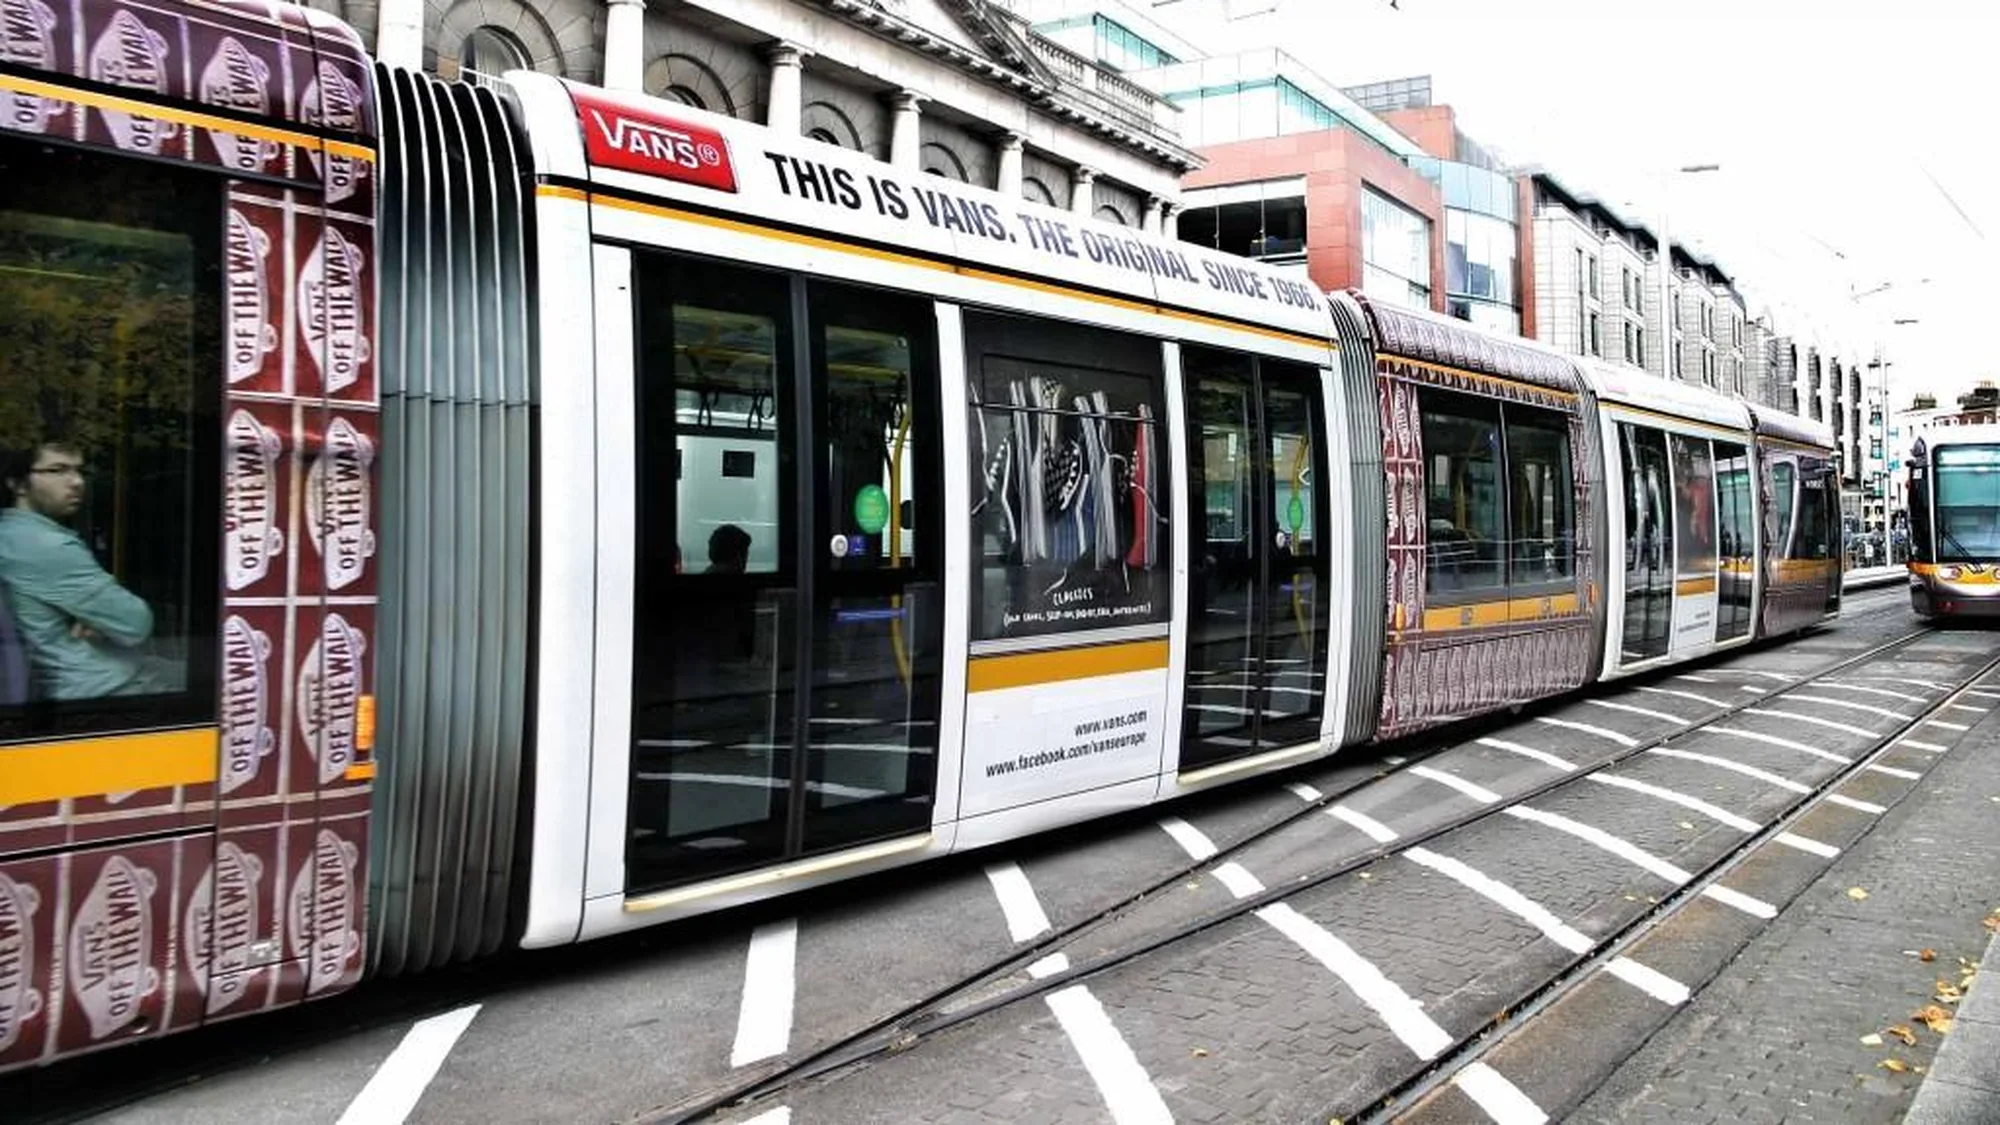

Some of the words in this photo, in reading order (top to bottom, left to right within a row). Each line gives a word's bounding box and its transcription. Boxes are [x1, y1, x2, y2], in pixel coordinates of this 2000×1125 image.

[763, 150, 862, 210] THIS
[867, 174, 909, 220] IS
[911, 186, 1017, 244] VANS.
[1016, 212, 1079, 258] THE
[1080, 229, 1200, 284] ORIGINAL
[1201, 259, 1269, 301] SINCE
[1268, 276, 1322, 312] 1966.
[325, 241, 352, 288] WALL
[232, 280, 258, 323] THE
[329, 292, 354, 334] THE
[234, 329, 257, 364] OFF
[332, 340, 352, 374] OFF
[235, 427, 266, 477] WALL
[335, 433, 361, 482] WALL
[237, 482, 266, 528] THE
[336, 488, 361, 530] THE
[239, 534, 262, 570] OFF
[337, 535, 358, 570] OFF
[226, 631, 256, 682] WALL
[326, 629, 353, 677] WALL
[230, 683, 257, 730] THE
[328, 681, 353, 724] THE
[1074, 709, 1148, 737] www.vans.com
[231, 737, 252, 772] OFF
[329, 730, 349, 764] OFF
[985, 731, 1147, 778] www.facebook.com/vanseurope
[218, 856, 247, 907] WALL
[318, 844, 345, 893] WALL
[107, 871, 140, 926] WALL
[319, 893, 345, 938] THE
[108, 925, 139, 973] THE
[219, 909, 248, 955] THE
[78, 921, 107, 992] VANS
[221, 960, 242, 993] OFF
[320, 943, 341, 975] OFF
[109, 981, 134, 1017] OFF
